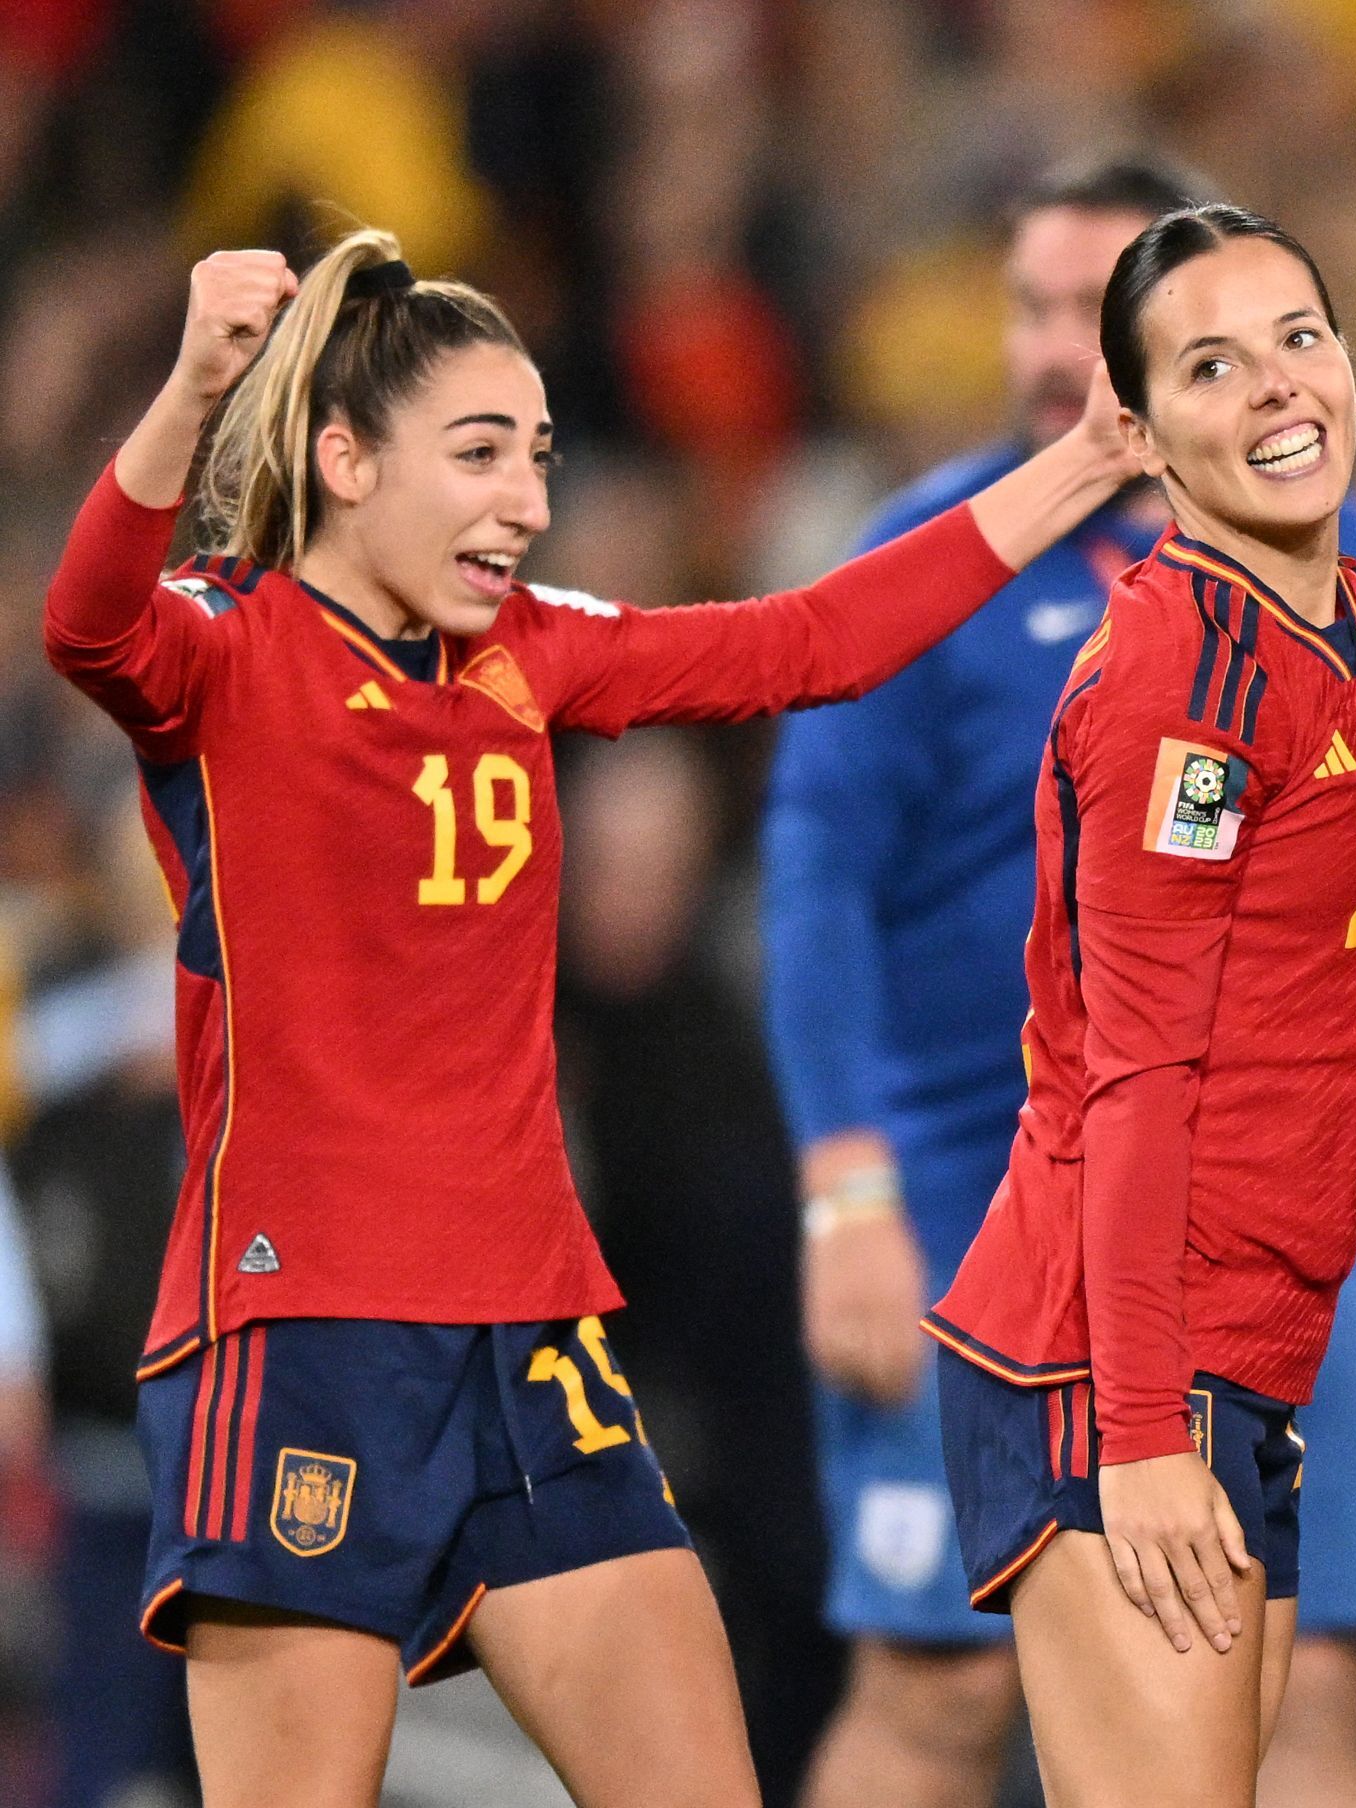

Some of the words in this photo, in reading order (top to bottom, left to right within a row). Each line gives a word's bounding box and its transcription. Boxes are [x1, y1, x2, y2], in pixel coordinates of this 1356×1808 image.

[1178, 801, 1194, 810] FIFA
[1176, 813, 1198, 822] WORLD
[414, 754, 533, 906] 19
[1173, 823, 1193, 835] AU
[1196, 826, 1215, 838] 20
[1172, 834, 1190, 845] NZ
[1194, 837, 1213, 848] 23
